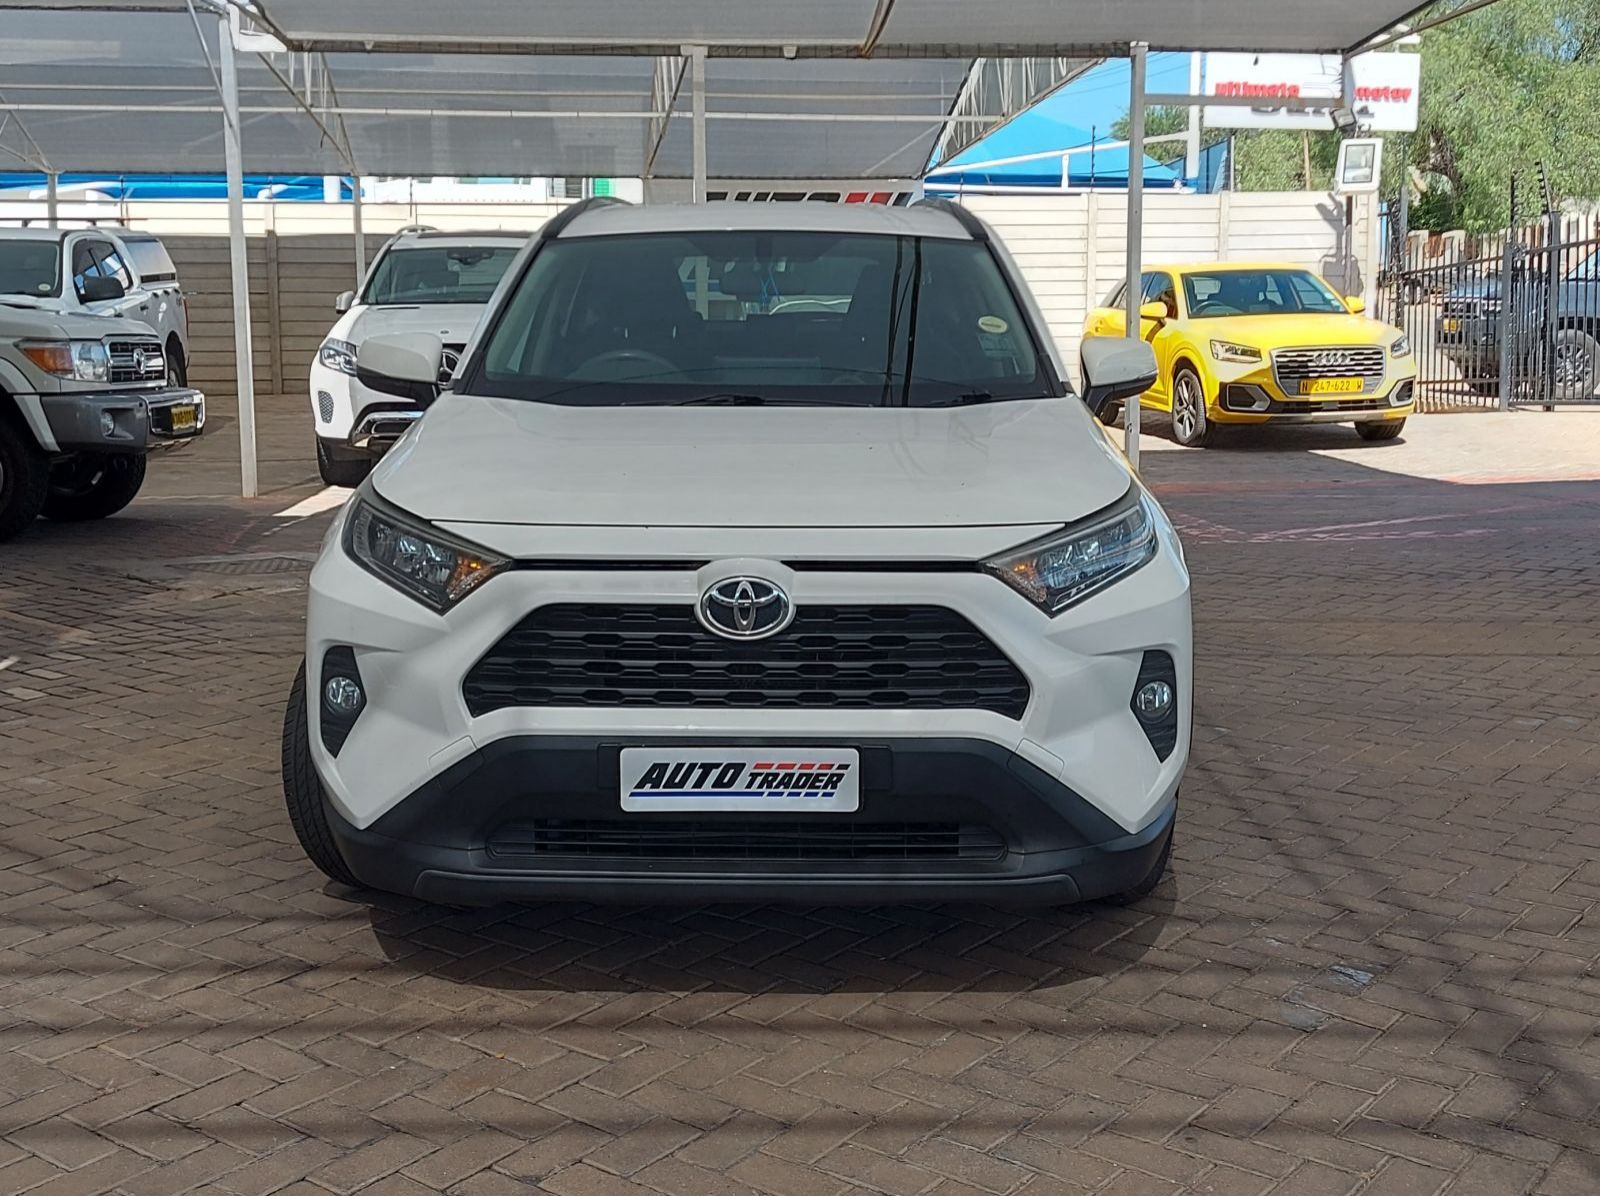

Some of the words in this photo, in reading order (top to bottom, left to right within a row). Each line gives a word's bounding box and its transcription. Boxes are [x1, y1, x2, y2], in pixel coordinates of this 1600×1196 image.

[1302, 382, 1308, 392] N
[633, 762, 747, 790] AUTO
[744, 772, 845, 790] TRADER
